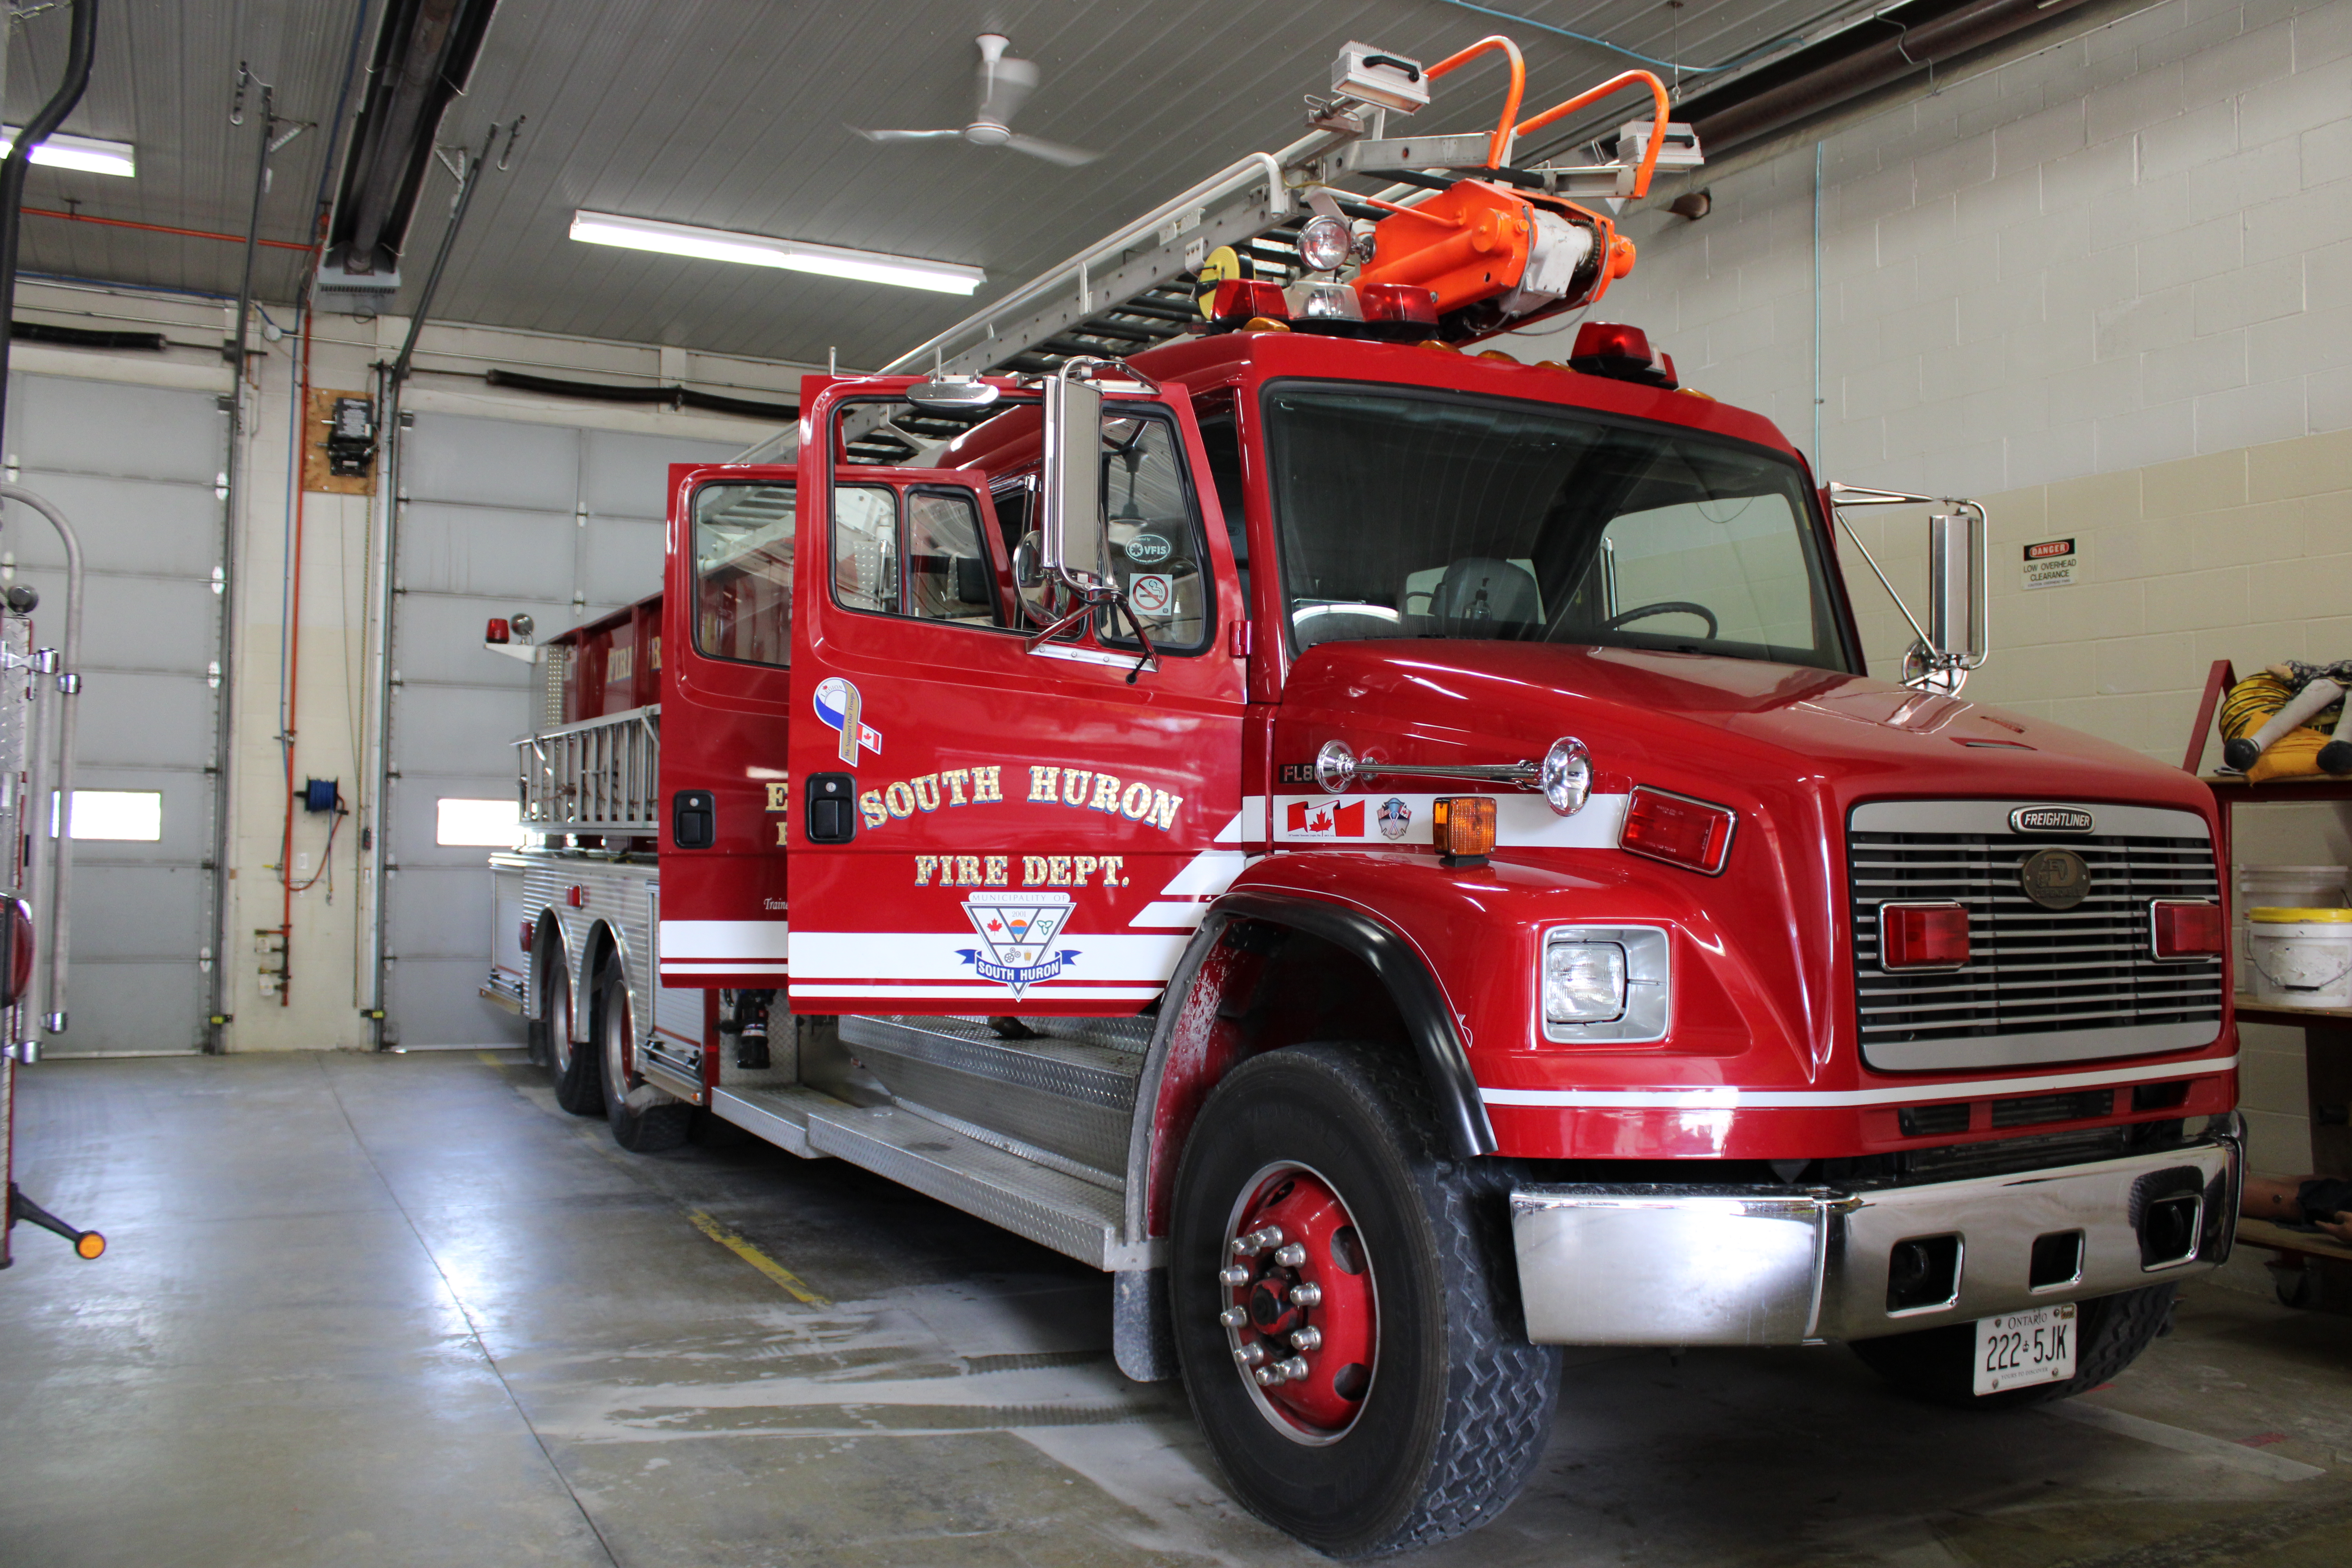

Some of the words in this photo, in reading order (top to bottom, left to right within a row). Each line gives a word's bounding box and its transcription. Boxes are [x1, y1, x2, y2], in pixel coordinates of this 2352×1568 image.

[1144, 546, 1166, 555] VFIS
[2032, 544, 2065, 555] DANGER
[2024, 564, 2038, 573] LOW
[2041, 559, 2076, 570] OVERHEAD
[2031, 569, 2070, 581] CLEARANCE
[820, 684, 843, 698] LEGION
[859, 765, 1004, 830] SOUTH
[1026, 765, 1183, 831] HURON
[2024, 813, 2090, 827] FREIGHTLINER
[914, 855, 1009, 887] FIRE
[1022, 855, 1130, 887] DEPT.
[978, 961, 1015, 981] SOUTH
[1020, 961, 1060, 981] HURON
[2008, 1312, 2048, 1330] ONTARIO
[1986, 1332, 2022, 1372] 222
[2034, 1325, 2067, 1364] 5JK
[2025, 1367, 2048, 1376] DISCOVER
